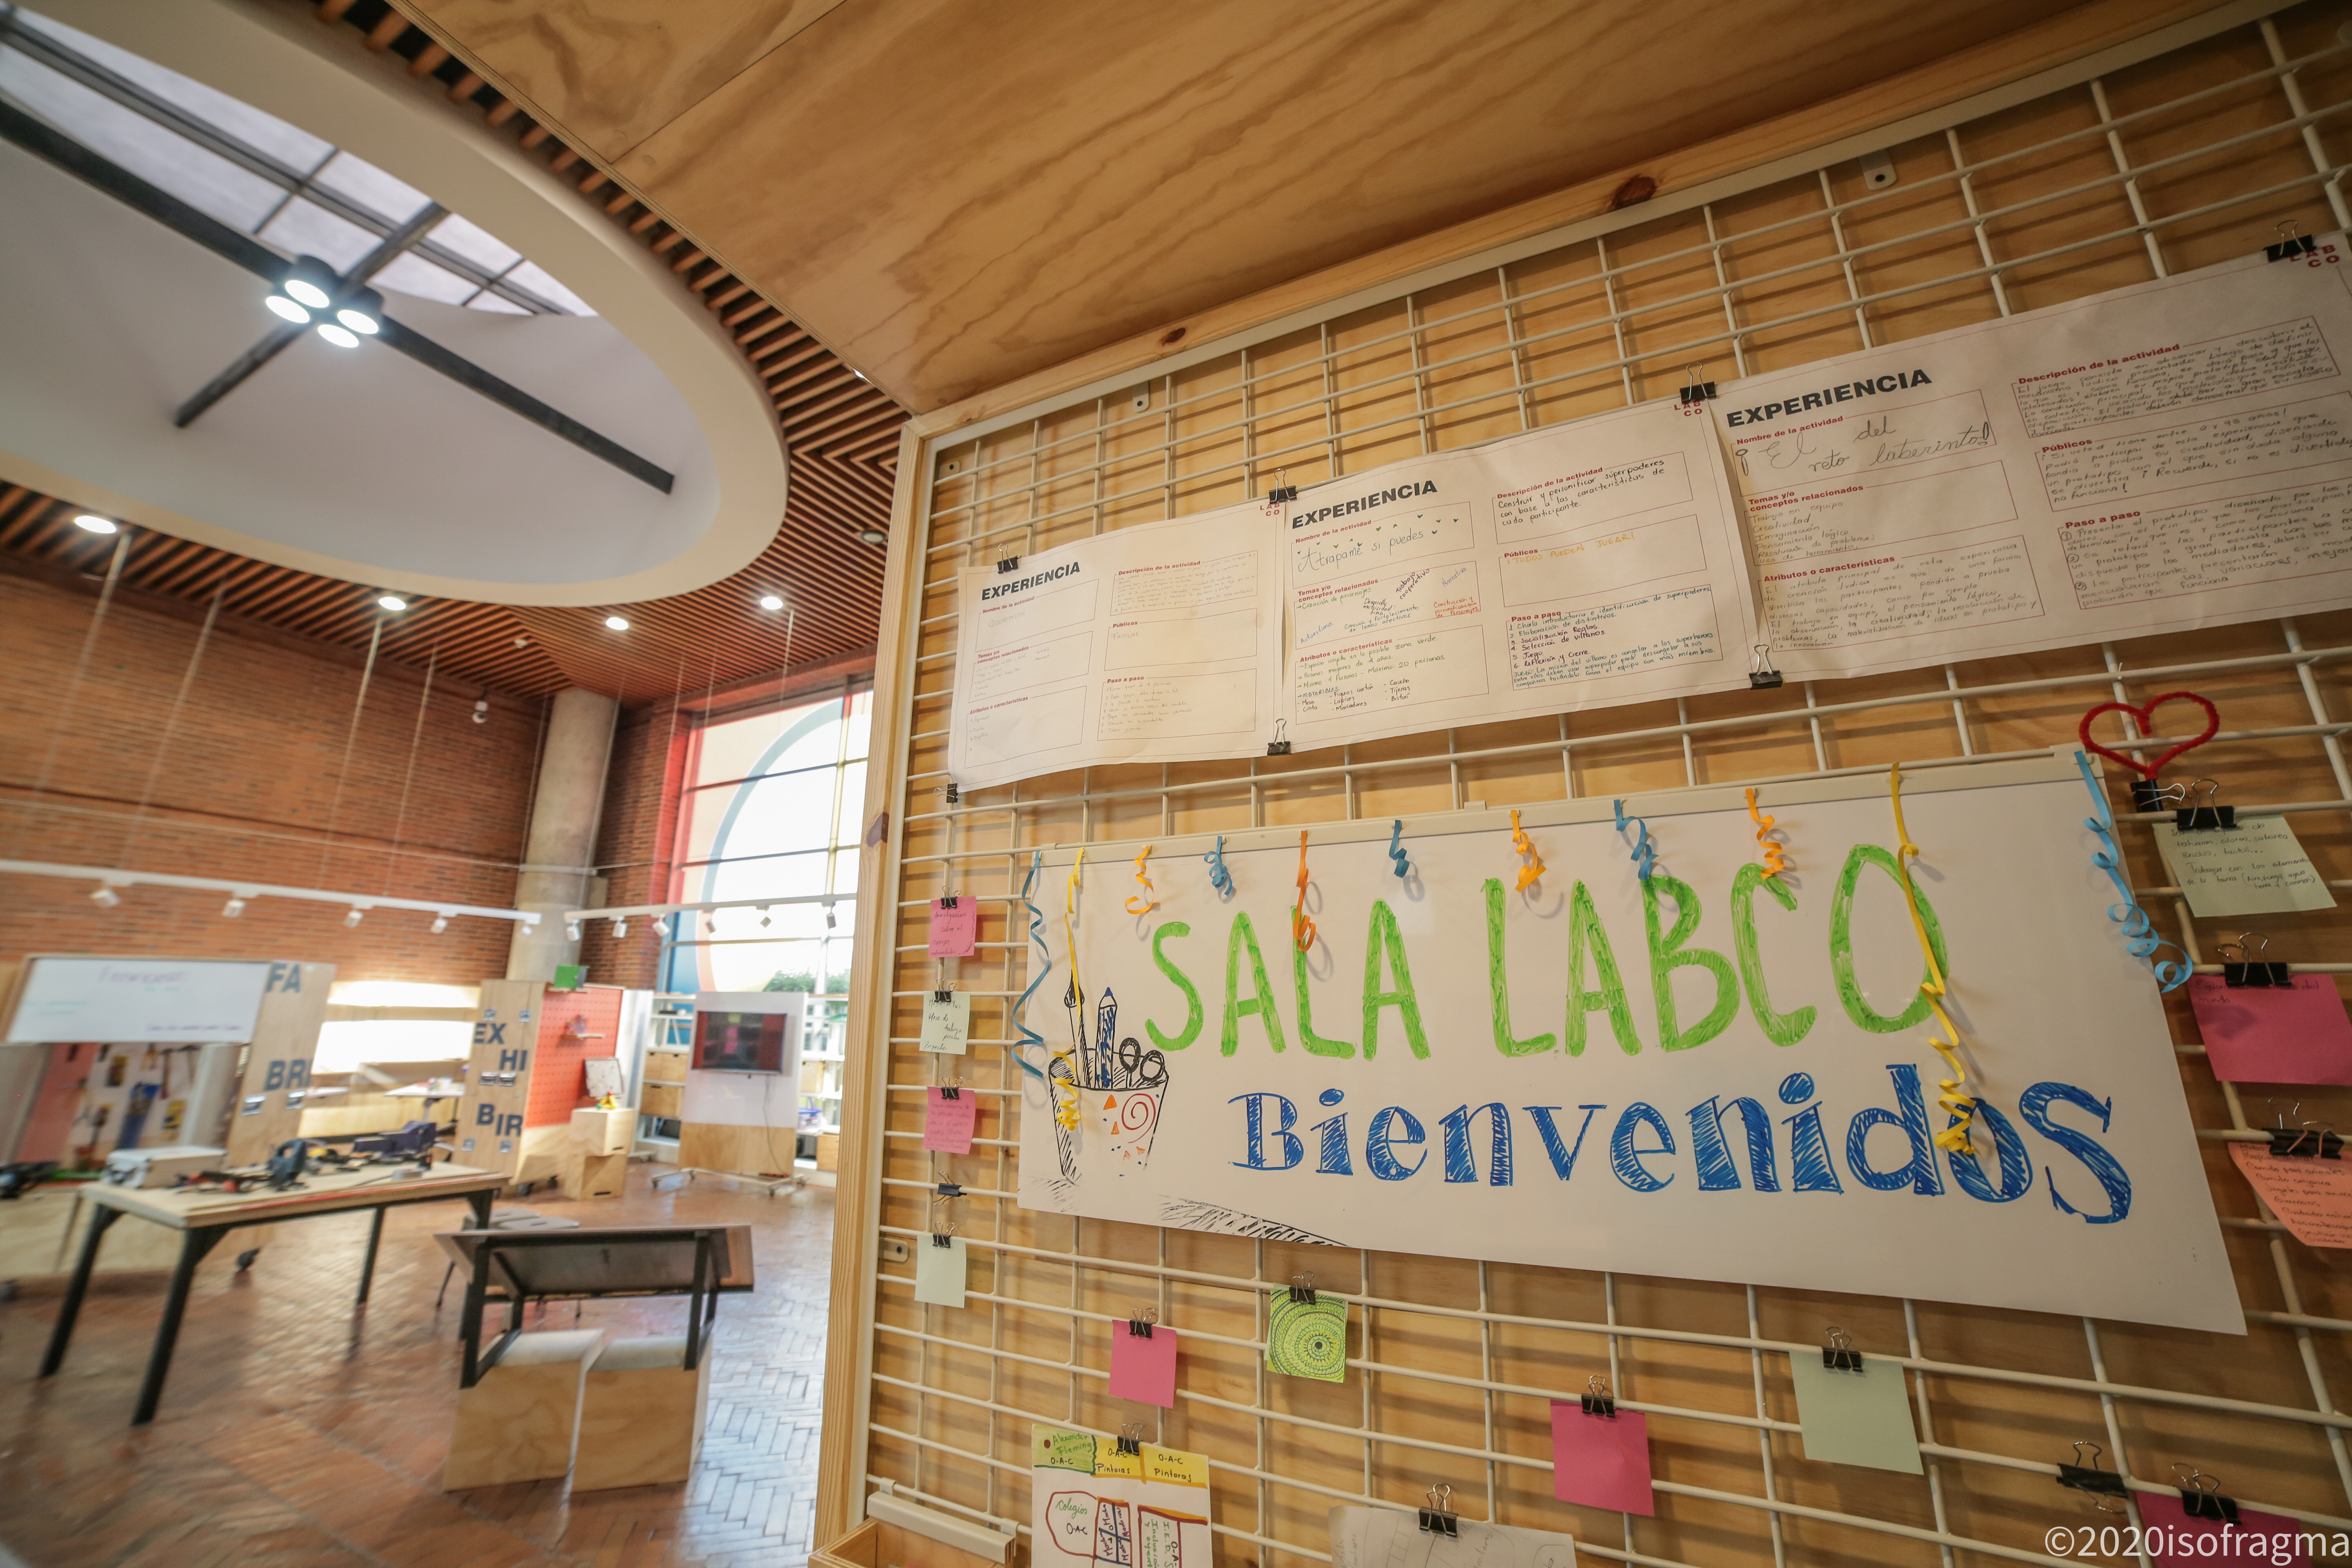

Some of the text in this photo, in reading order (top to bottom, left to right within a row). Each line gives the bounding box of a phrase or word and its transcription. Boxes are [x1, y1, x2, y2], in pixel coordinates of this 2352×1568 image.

[2290, 245, 2336, 262] LAB
[2308, 255, 2340, 268] CO
[2018, 365, 2087, 385] Descripción
[2089, 362, 2104, 370] de
[2122, 344, 2181, 363] actividad
[1674, 401, 1701, 410] LAB
[1727, 369, 1932, 428] EXPERIENCIA
[1737, 434, 1771, 445] Nombre
[1800, 415, 1844, 432] actividad
[1853, 416, 1897, 443] del
[2042, 439, 2093, 453] Públicos
[1809, 449, 1850, 473] reto
[1497, 484, 1543, 499] Descripción
[1566, 468, 1603, 481] actividad
[1498, 496, 1532, 508] Construir
[1541, 492, 1546, 504] y
[1549, 477, 1596, 497] personificar
[1260, 502, 1280, 510] LAB
[1292, 480, 1438, 529] EXPERIENCIA
[1748, 491, 1795, 505] Temas y/o
[1750, 484, 1864, 512] conceptos relacionados
[1519, 505, 1537, 514] base
[1749, 512, 1783, 525] Trabajo
[1810, 501, 1843, 512] equipo
[2065, 520, 2095, 529] Paso
[2111, 510, 2140, 523] paso
[1296, 533, 1320, 543] Nombre
[1339, 520, 1372, 531] actividad
[1502, 517, 1523, 526] cada
[1753, 514, 1811, 533] Creatividad
[1372, 541, 1380, 551] si
[1390, 528, 1423, 555] puedes
[1755, 524, 1820, 542] Imaginación
[1755, 529, 1849, 551] Pensamiento lógico
[1504, 548, 1538, 558] Públicos
[1118, 567, 1154, 575] Descripción
[1764, 569, 1807, 582] Atributos
[1819, 556, 1895, 574] características
[982, 561, 1080, 600] EXPERIENCIA
[1298, 587, 1319, 595] Temas
[1298, 579, 1378, 603] conceptos relacionados
[1396, 572, 1416, 593] Trabajo
[1399, 568, 1430, 599] cooperativo
[1014, 596, 1035, 606] actividad
[1541, 611, 1561, 619] paso
[1521, 630, 1568, 644] Socialización
[1522, 640, 1555, 650] Selección
[977, 655, 1000, 664] conceptos
[1001, 646, 1029, 657] relacionados
[1300, 652, 1331, 662] Atributos
[1339, 638, 1392, 653] características
[1304, 661, 1324, 671] Espacio
[1369, 646, 1390, 659] posible
[1524, 653, 1564, 667] Reflexión y
[1328, 664, 1351, 675] mayores
[1334, 690, 1354, 699] Figuras
[1357, 684, 1374, 693] cartón
[1390, 686, 1410, 694] Tijeras
[994, 697, 1028, 708] características
[1145, 844, 1949, 1060] SALA LABCO
[265, 963, 301, 993] FA
[474, 1023, 506, 1044] EX
[499, 1050, 528, 1071] HI
[476, 1104, 523, 1137] BIR
[1228, 1064, 2133, 1225] Bienvenidos
[1056, 1442, 1091, 1456] Fleming
[1056, 1498, 1087, 1519] Colegios
